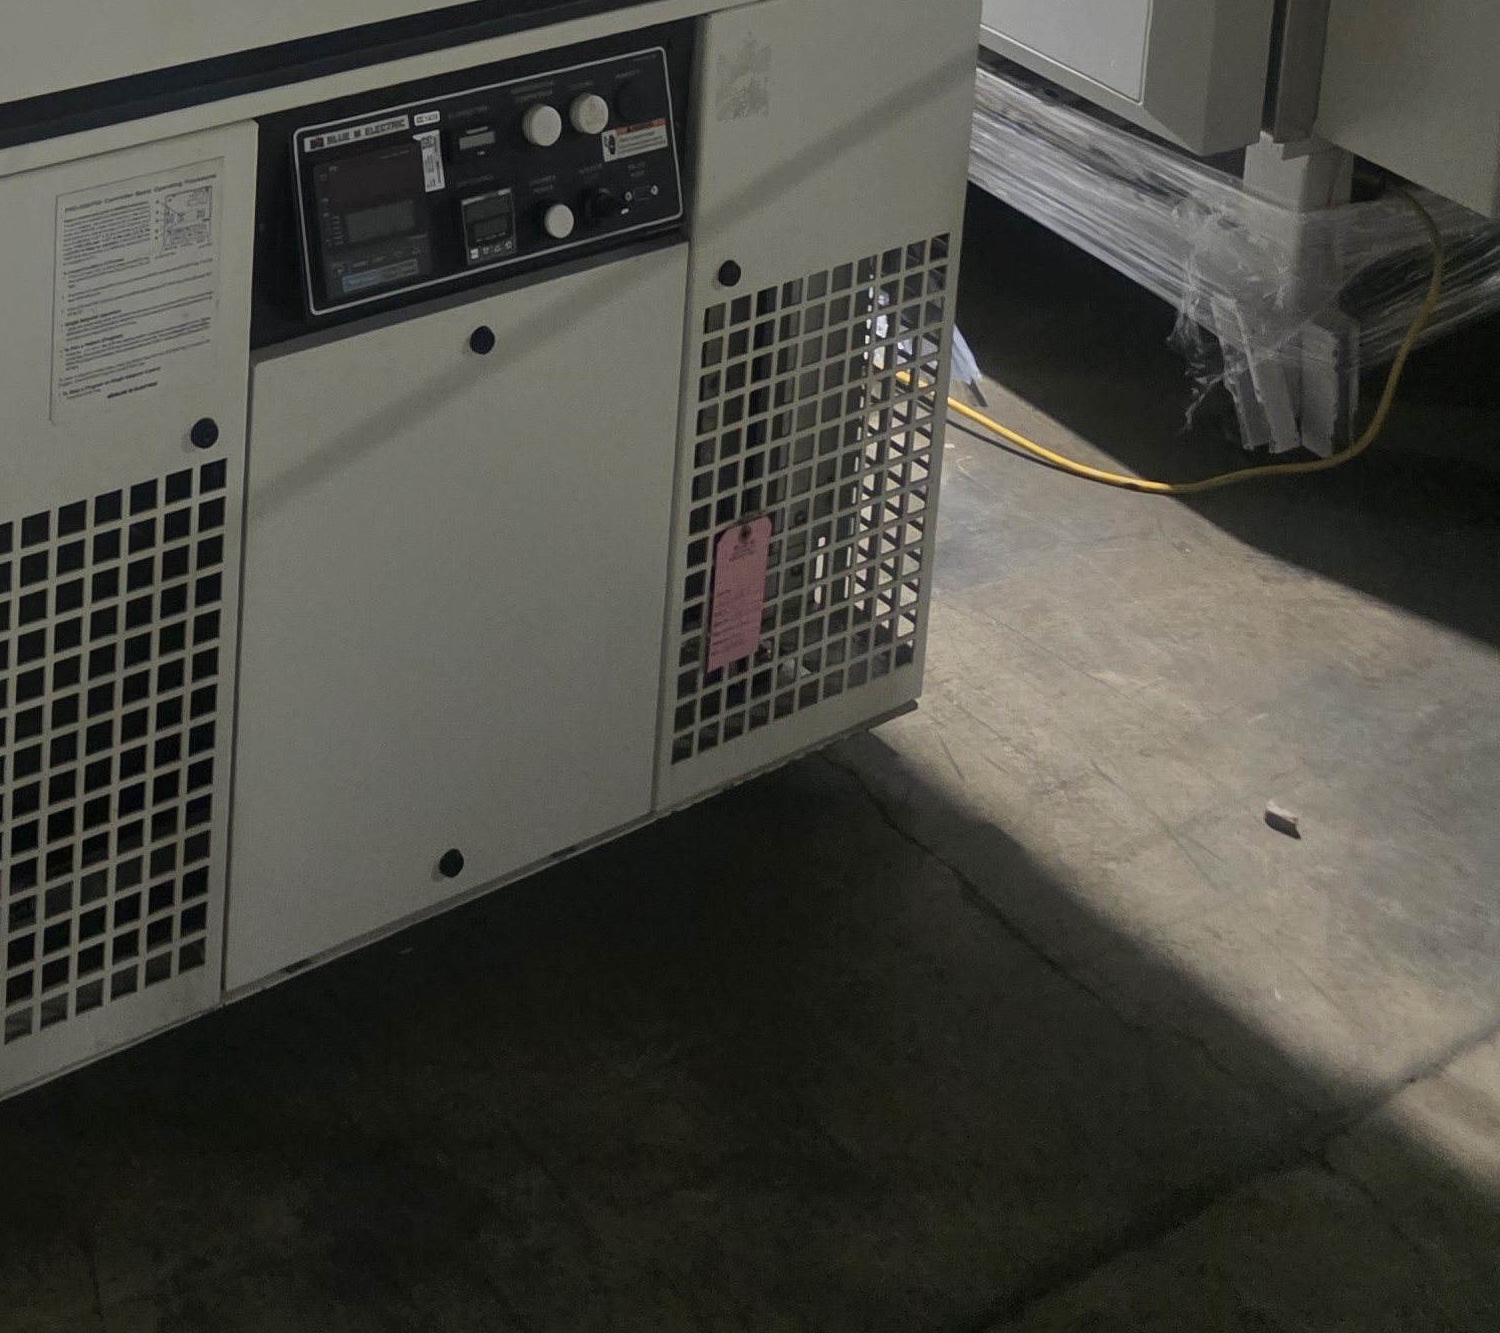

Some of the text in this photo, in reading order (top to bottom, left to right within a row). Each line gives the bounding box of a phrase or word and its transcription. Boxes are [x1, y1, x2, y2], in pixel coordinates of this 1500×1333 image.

[327, 118, 406, 146] BLUE M ELECTRIC
